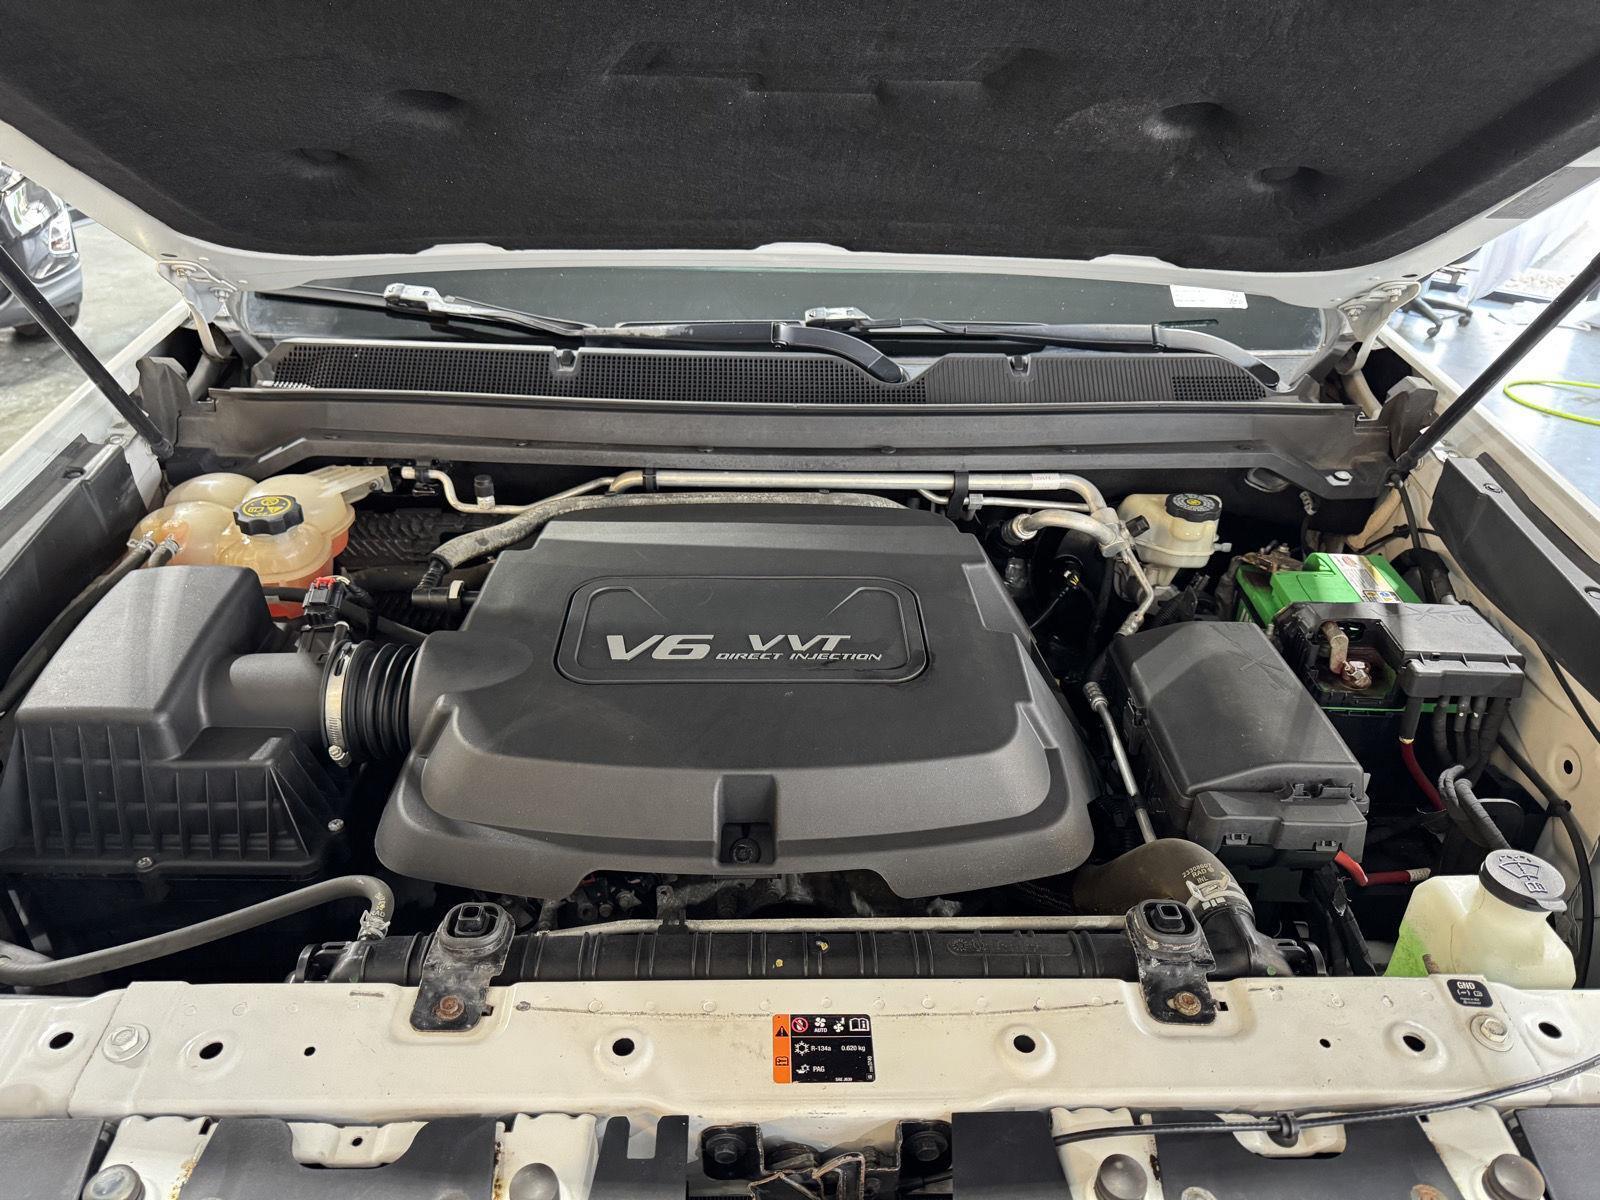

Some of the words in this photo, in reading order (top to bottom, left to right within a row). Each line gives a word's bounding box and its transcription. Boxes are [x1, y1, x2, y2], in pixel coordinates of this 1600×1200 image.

[606, 634, 714, 661] V6
[748, 634, 851, 652] VVT
[715, 652, 784, 661] DIRECT
[789, 652, 883, 662] INJECTION
[1191, 868, 1207, 878] RAD
[1457, 981, 1476, 990] GND
[812, 1065, 826, 1073] PAG
